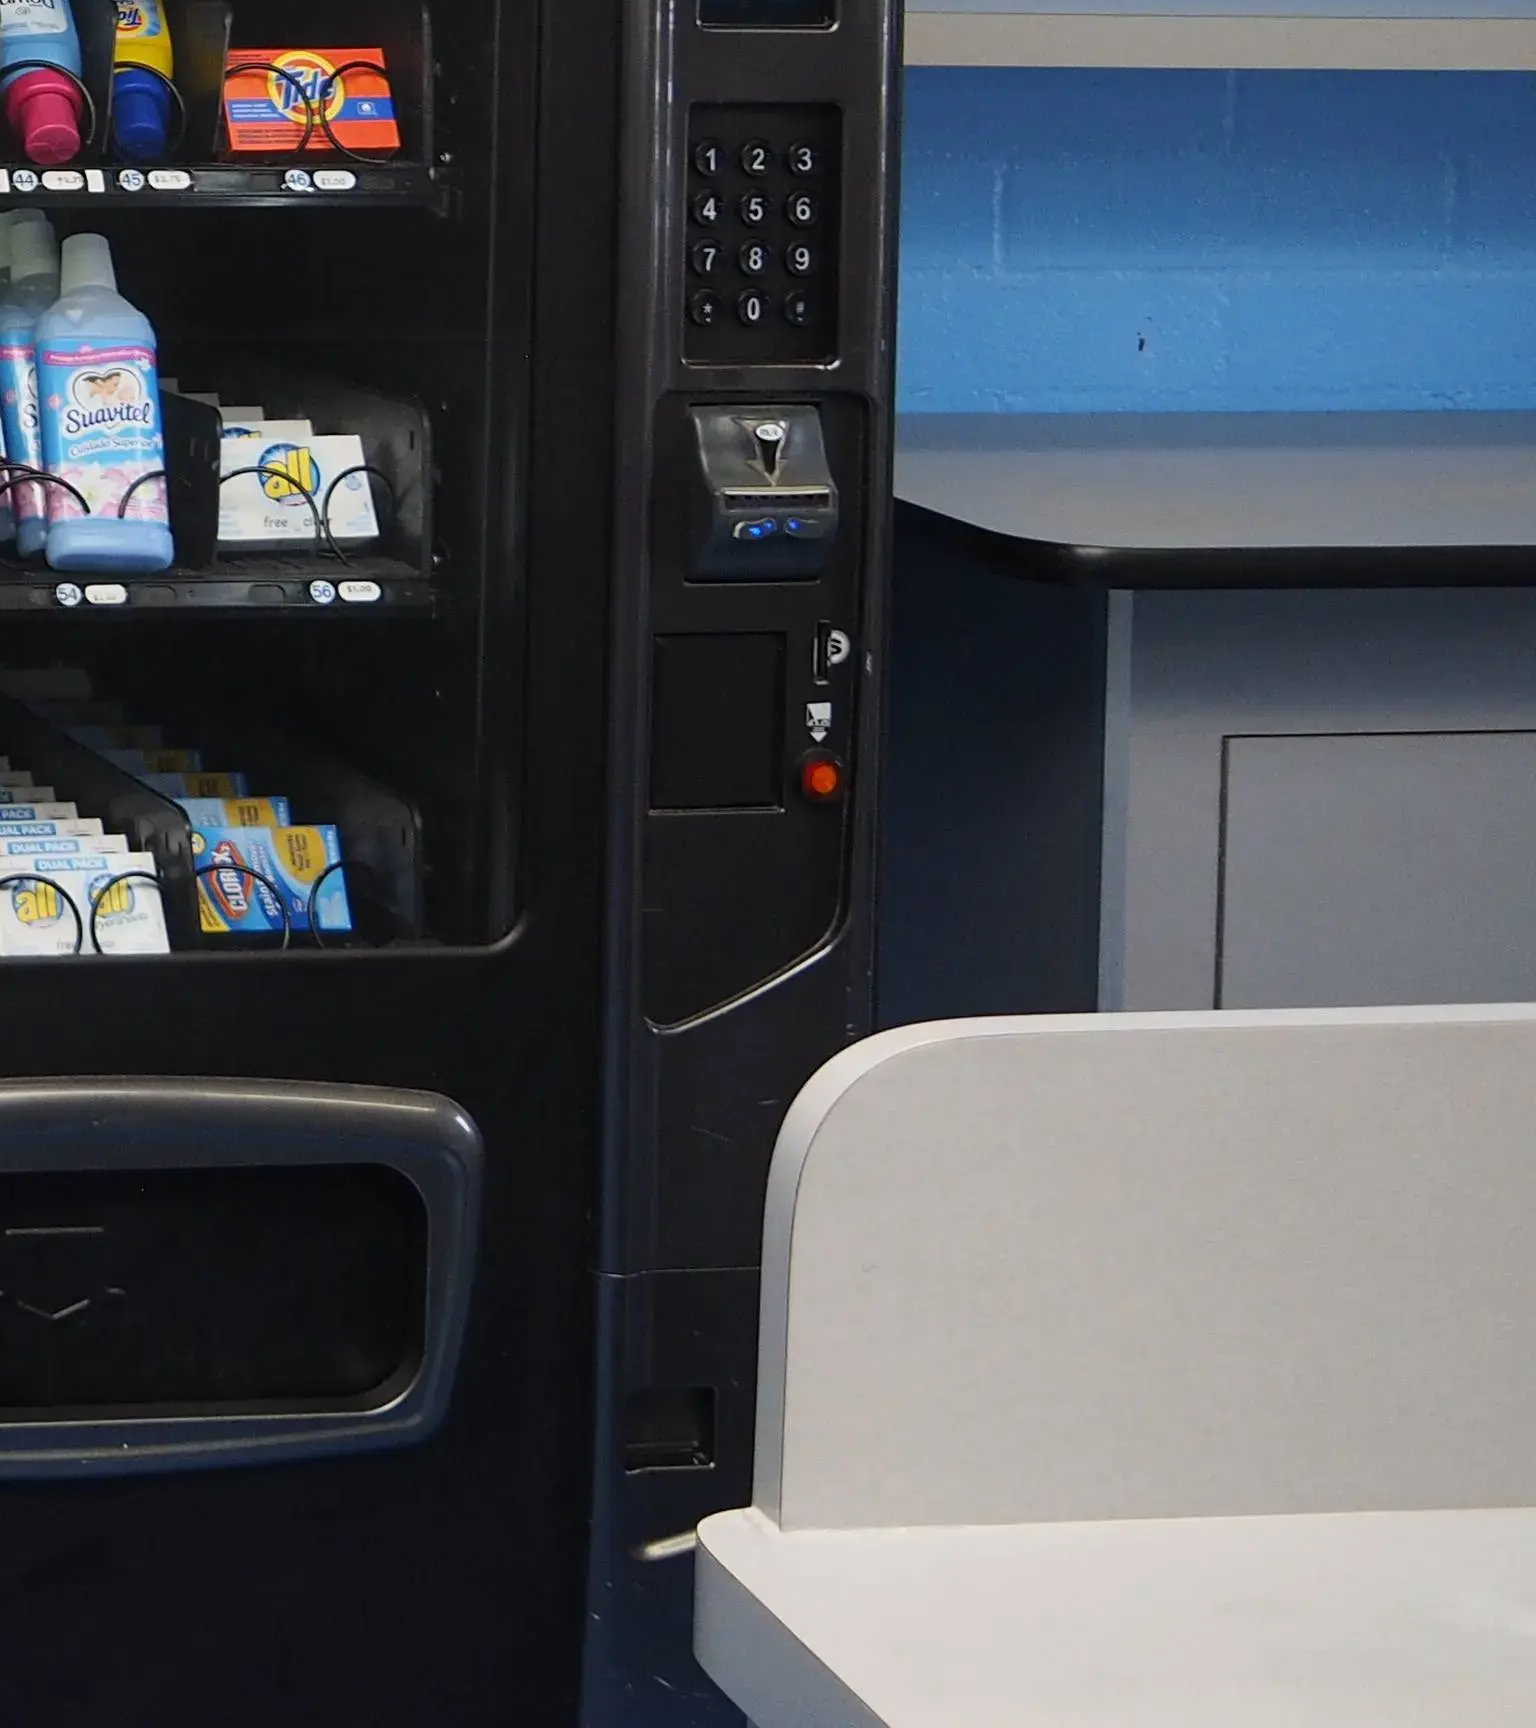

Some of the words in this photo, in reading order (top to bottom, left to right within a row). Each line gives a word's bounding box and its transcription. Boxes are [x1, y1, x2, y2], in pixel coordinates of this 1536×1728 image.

[275, 65, 336, 109] Tide
[706, 150, 716, 170] 1
[752, 149, 765, 170] 2
[798, 149, 811, 170] 3
[122, 173, 141, 186] 45
[702, 199, 716, 220] 4
[749, 199, 764, 220] 5
[796, 199, 810, 220] 6
[702, 250, 716, 270] 7
[749, 248, 762, 268] 8
[795, 248, 809, 269] 9
[747, 298, 760, 320] 0
[65, 402, 151, 435] Suavitel
[264, 446, 313, 502] all
[263, 516, 288, 528] free
[59, 587, 77, 601] 54
[312, 585, 331, 599] 56
[12, 844, 43, 853] DUAL
[45, 843, 76, 852] PACK
[39, 861, 71, 870] DUAL
[73, 860, 104, 869] PACK
